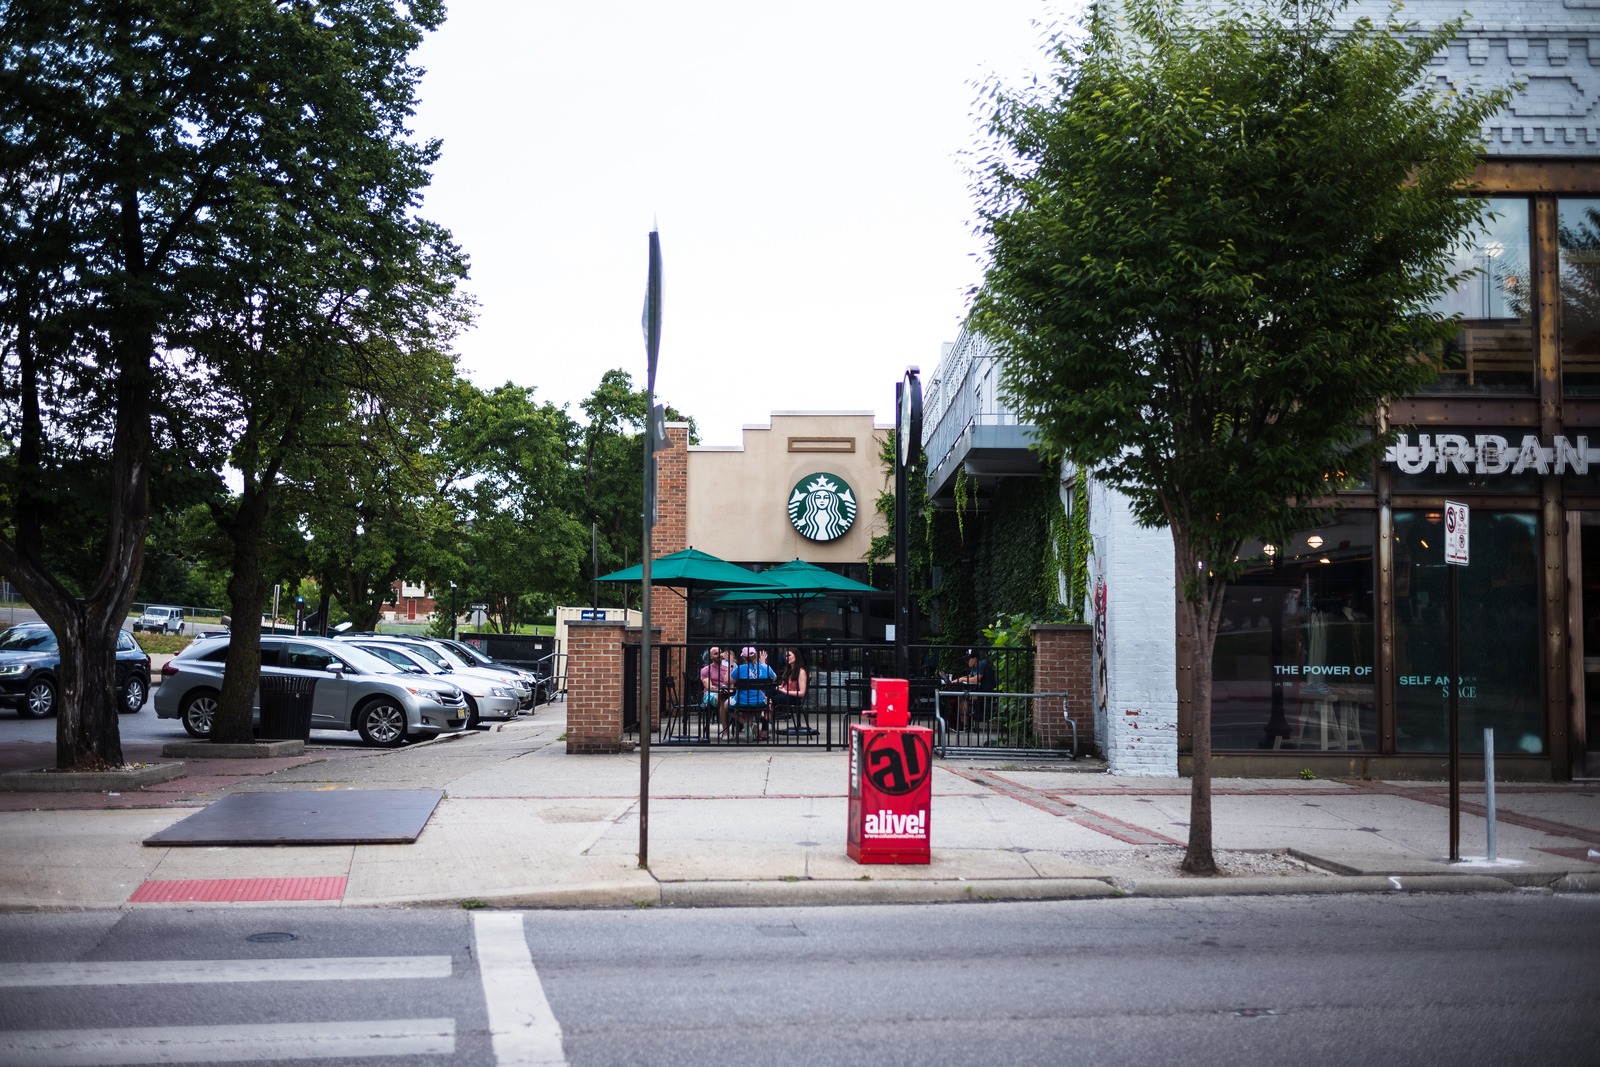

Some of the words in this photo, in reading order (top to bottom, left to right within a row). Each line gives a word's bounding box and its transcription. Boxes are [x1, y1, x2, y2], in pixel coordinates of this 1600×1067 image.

[1397, 434, 1589, 475] URBAN
[1274, 665, 1299, 675] THE
[1303, 665, 1350, 675] POWER
[1354, 666, 1373, 676] OF
[1400, 676, 1431, 685] SELF
[865, 809, 925, 834] alive!
